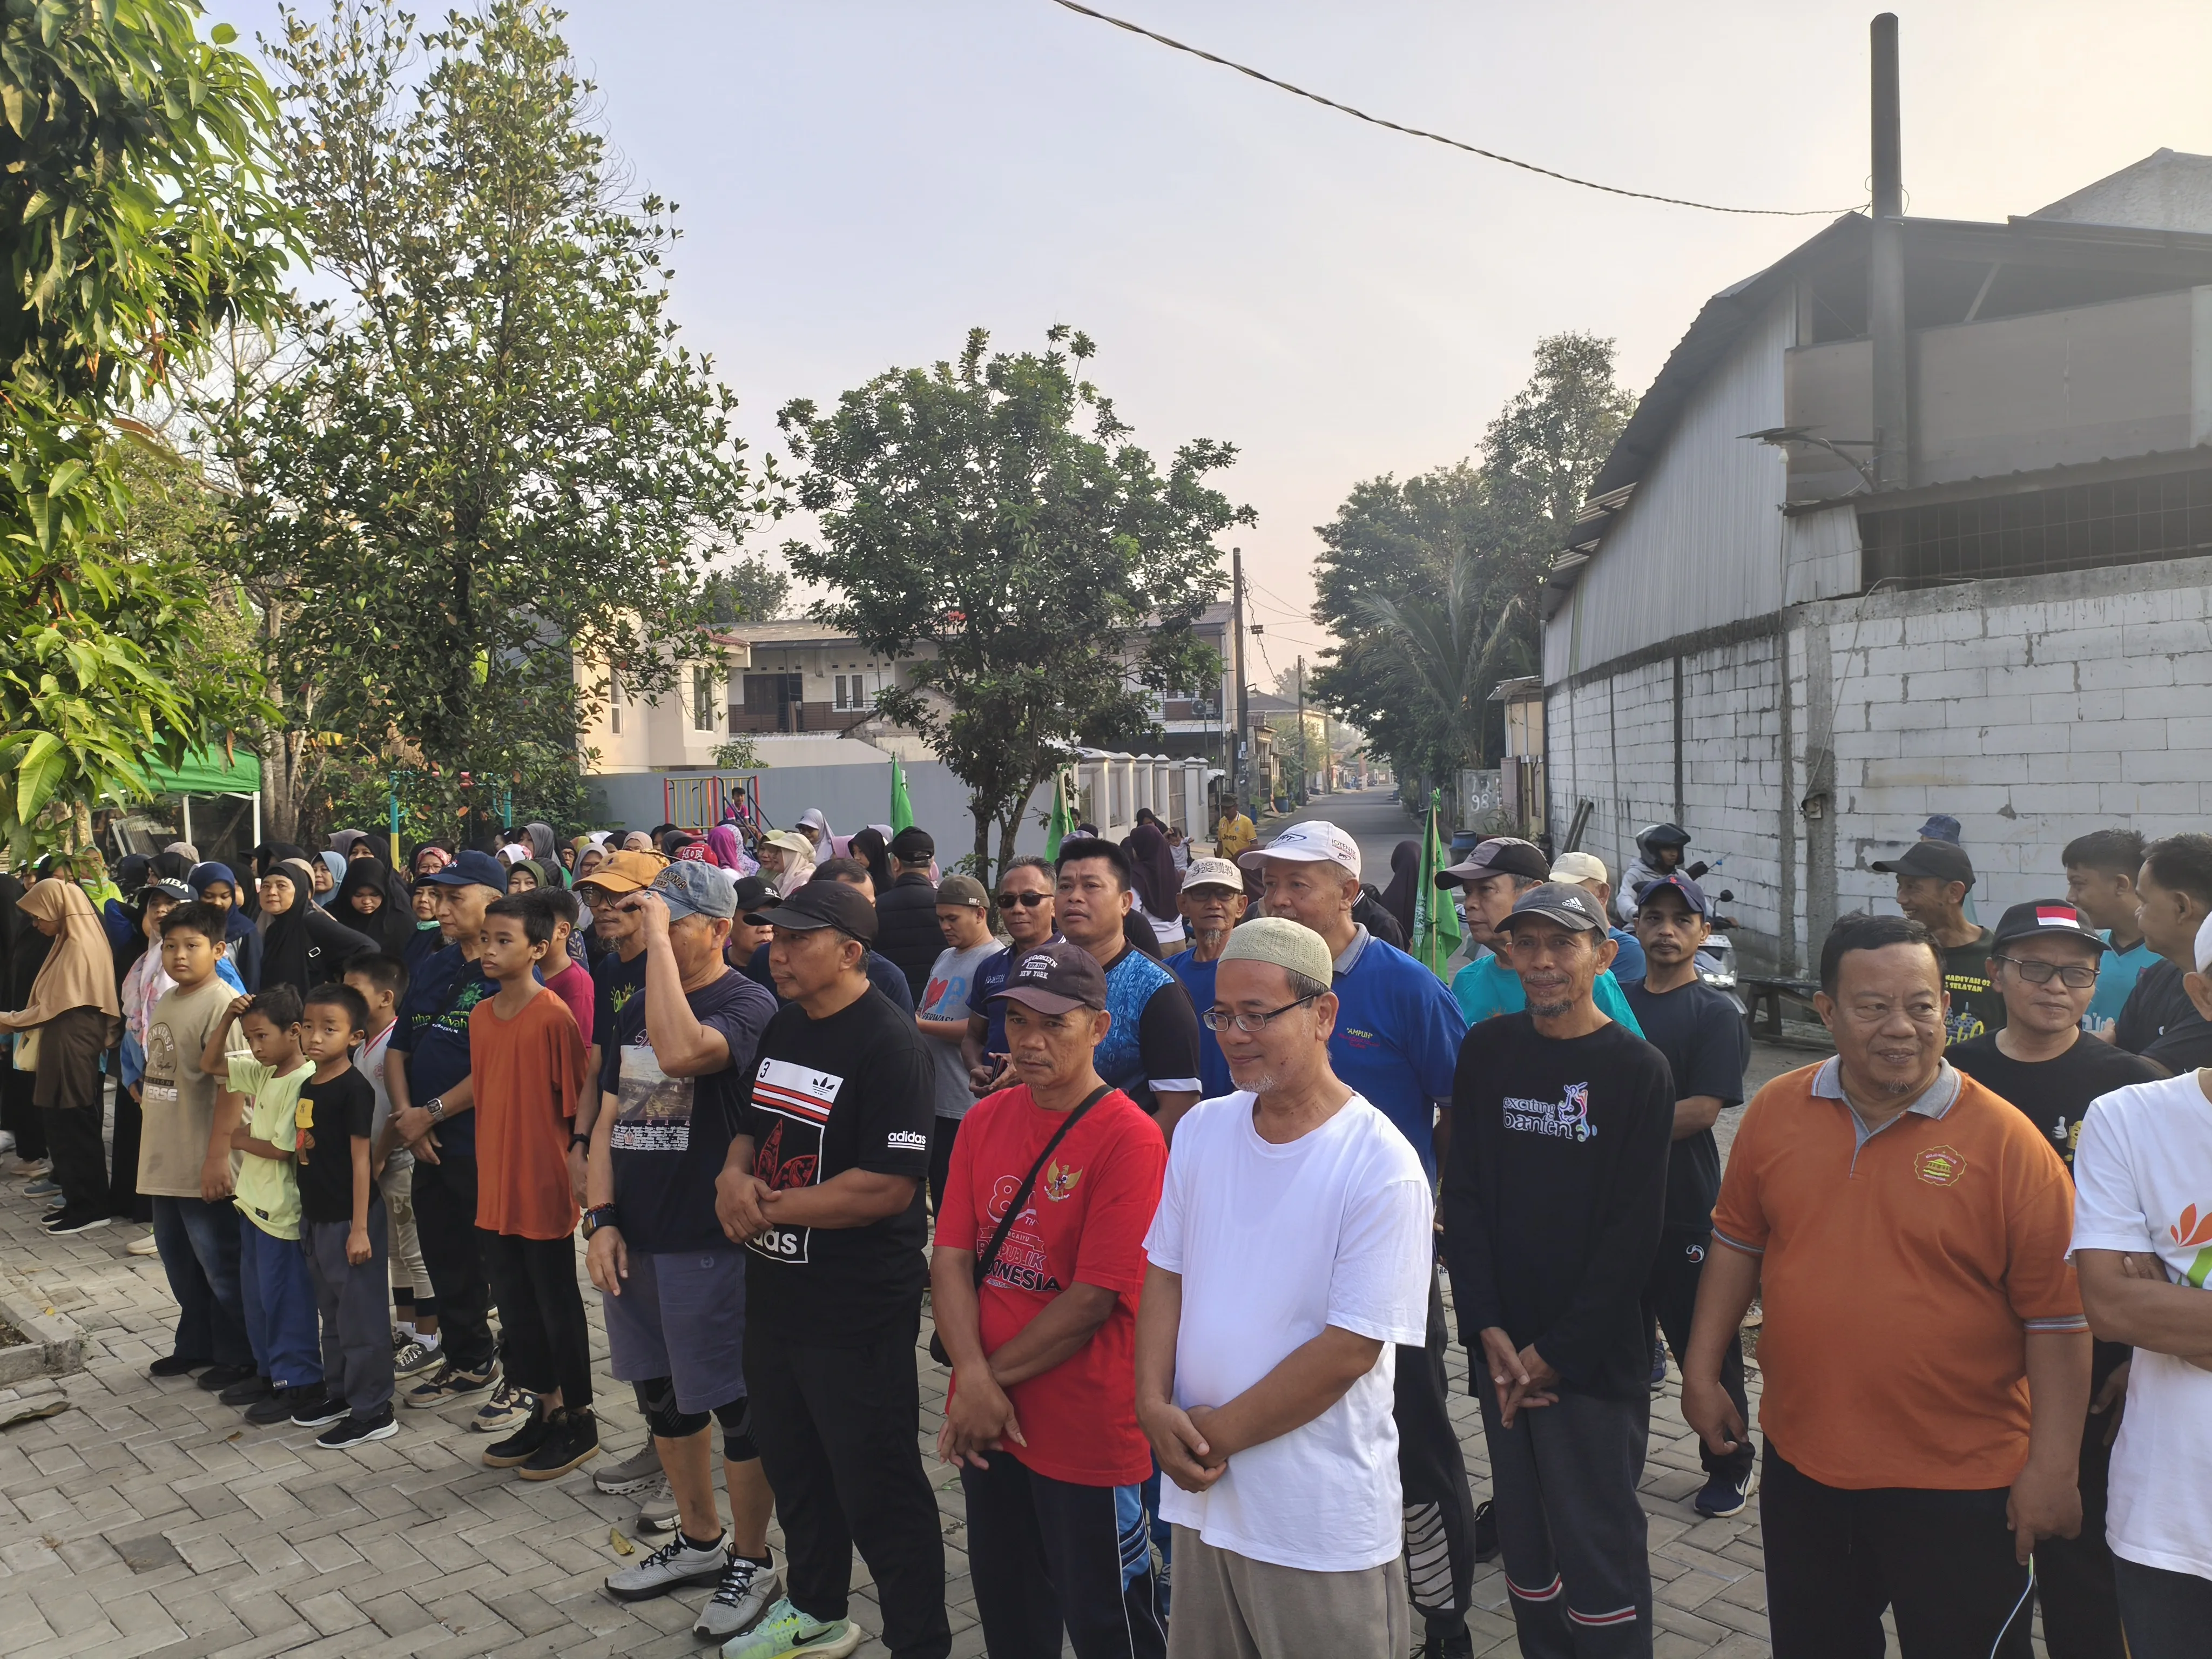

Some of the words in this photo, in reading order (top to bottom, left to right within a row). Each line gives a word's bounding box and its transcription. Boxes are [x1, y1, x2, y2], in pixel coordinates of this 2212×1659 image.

[1472, 794, 1489, 811] 98
[1562, 901, 1586, 912] adidas
[1033, 970, 1048, 979] YORK
[759, 1061, 771, 1078] 3
[1503, 1107, 1573, 1139] banten
[888, 1130, 926, 1144] adidas
[977, 1239, 1046, 1271] RPUBLIK
